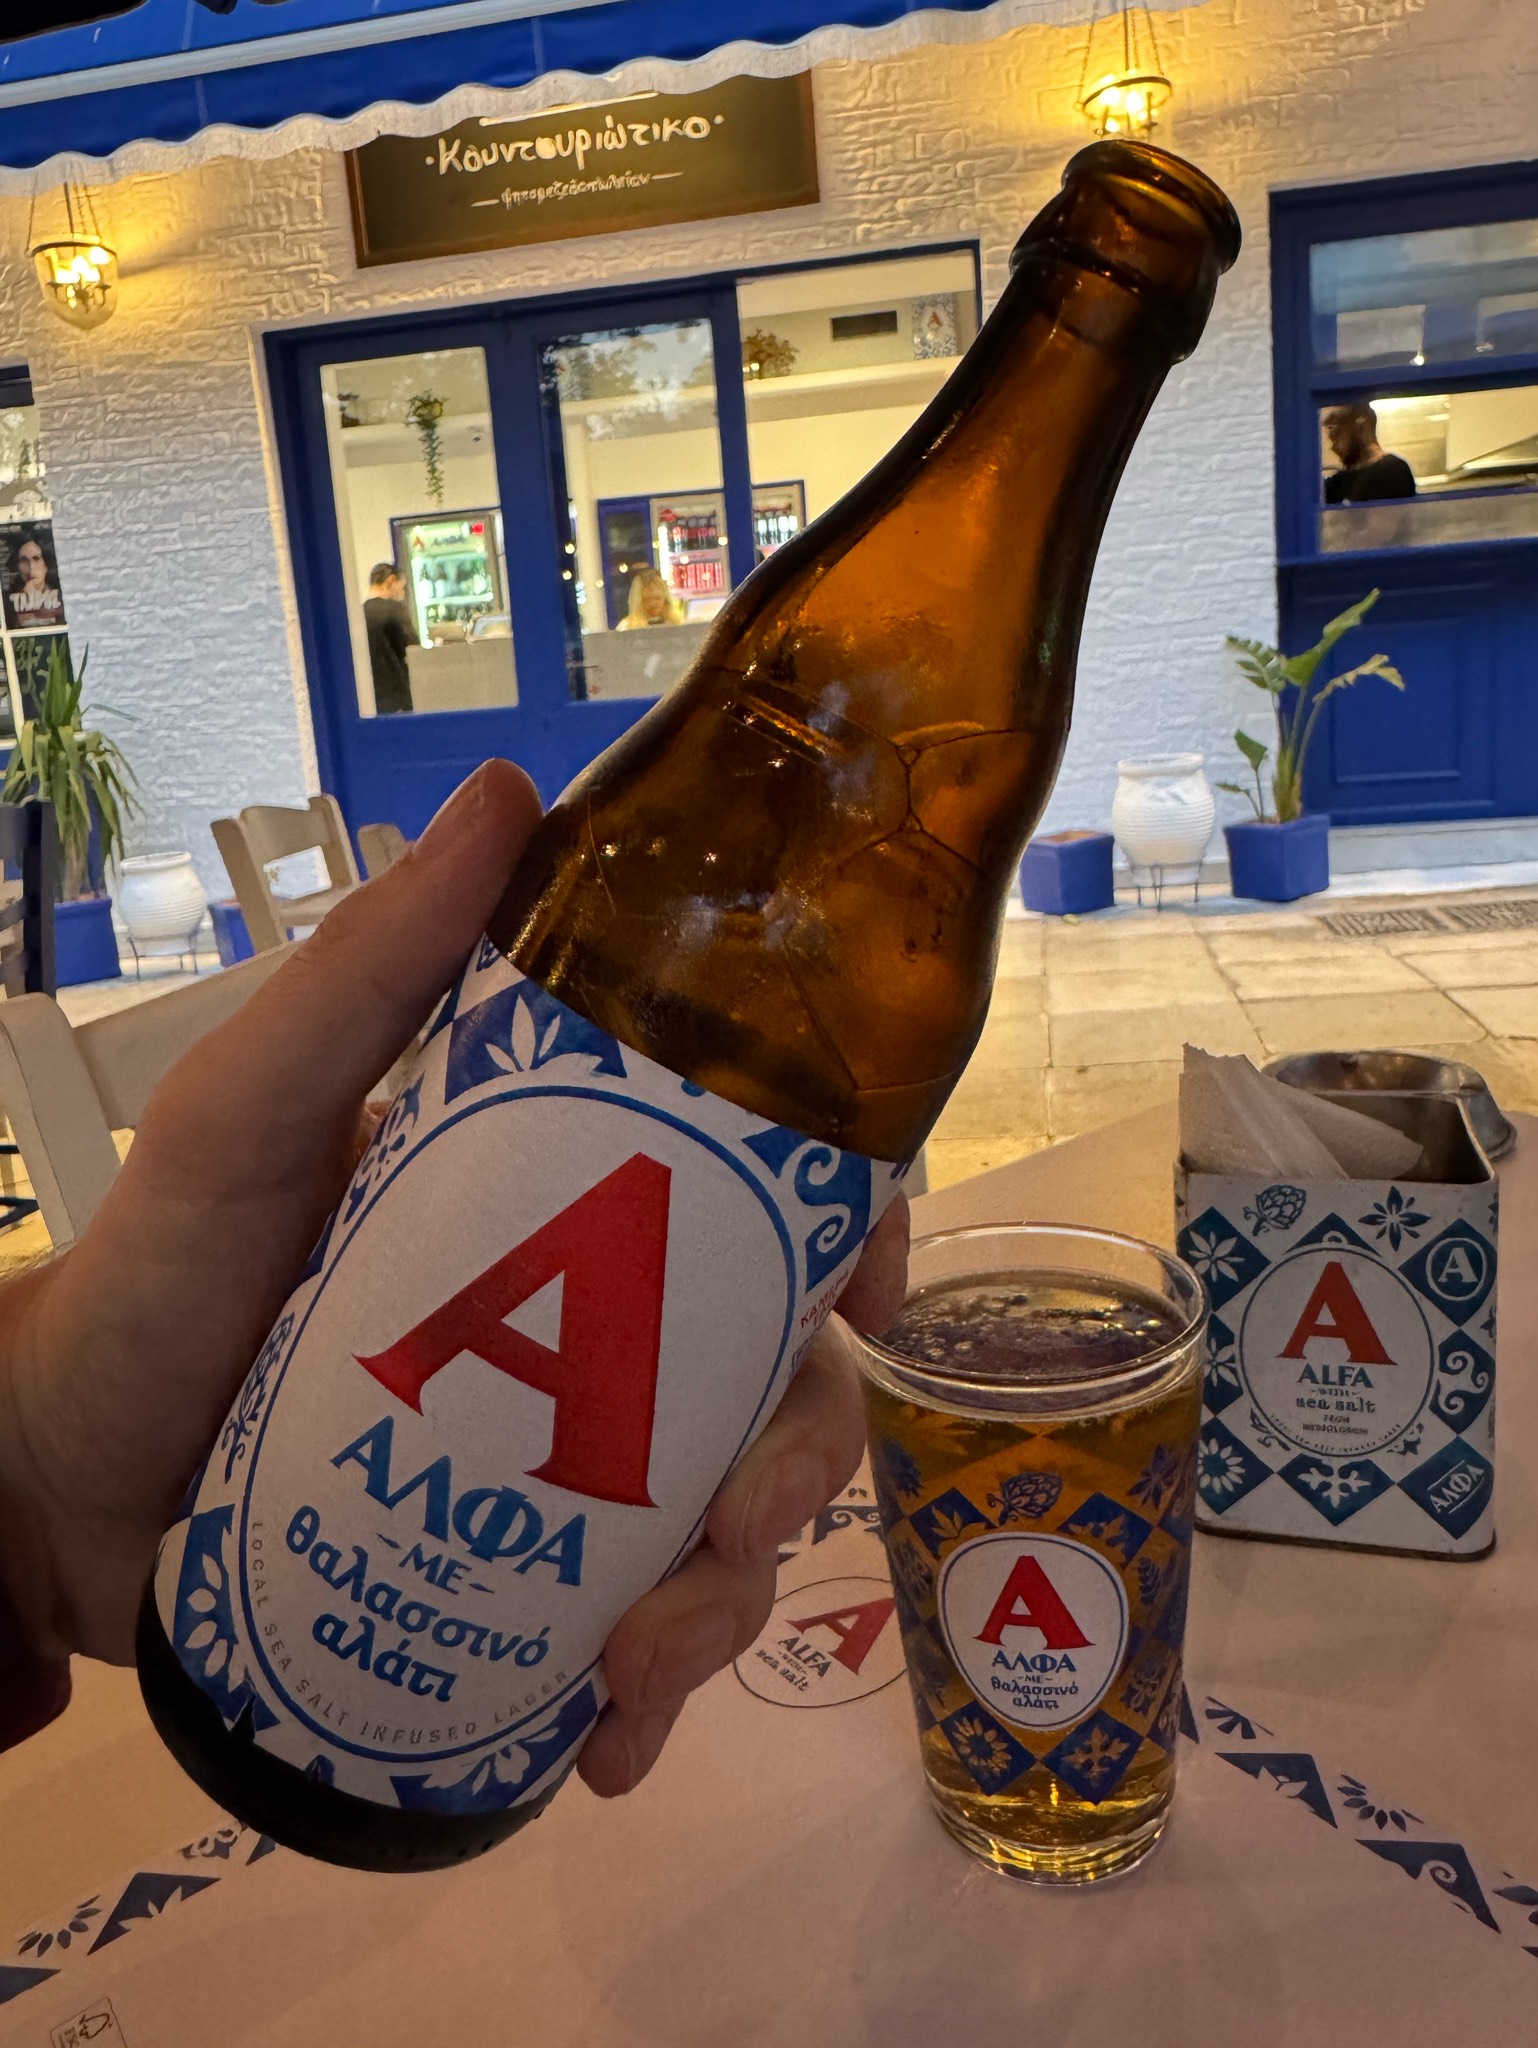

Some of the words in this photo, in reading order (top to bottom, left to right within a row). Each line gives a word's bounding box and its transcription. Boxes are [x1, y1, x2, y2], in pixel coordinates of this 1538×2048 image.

[1296, 1363, 1374, 1388] ALFA
[329, 1414, 587, 1588] ΑΛΦΑ
[1430, 1464, 1485, 1513] ΑΛΦΑ
[285, 1504, 552, 1669] θαλασσινό
[251, 1521, 270, 1608] LOCAL
[264, 1622, 294, 1674] SEA
[296, 1678, 351, 1727] SALT
[359, 1719, 478, 1745] INFUSED
[493, 1668, 569, 1725] LAGER
[311, 1612, 459, 1703] αλάτι
[777, 1636, 832, 1679] ALFA
[991, 1649, 1077, 1674] ΑΛΦΑ
[990, 1675, 1080, 1697] θαλασσινό
[1012, 1695, 1059, 1710] αλάτι
